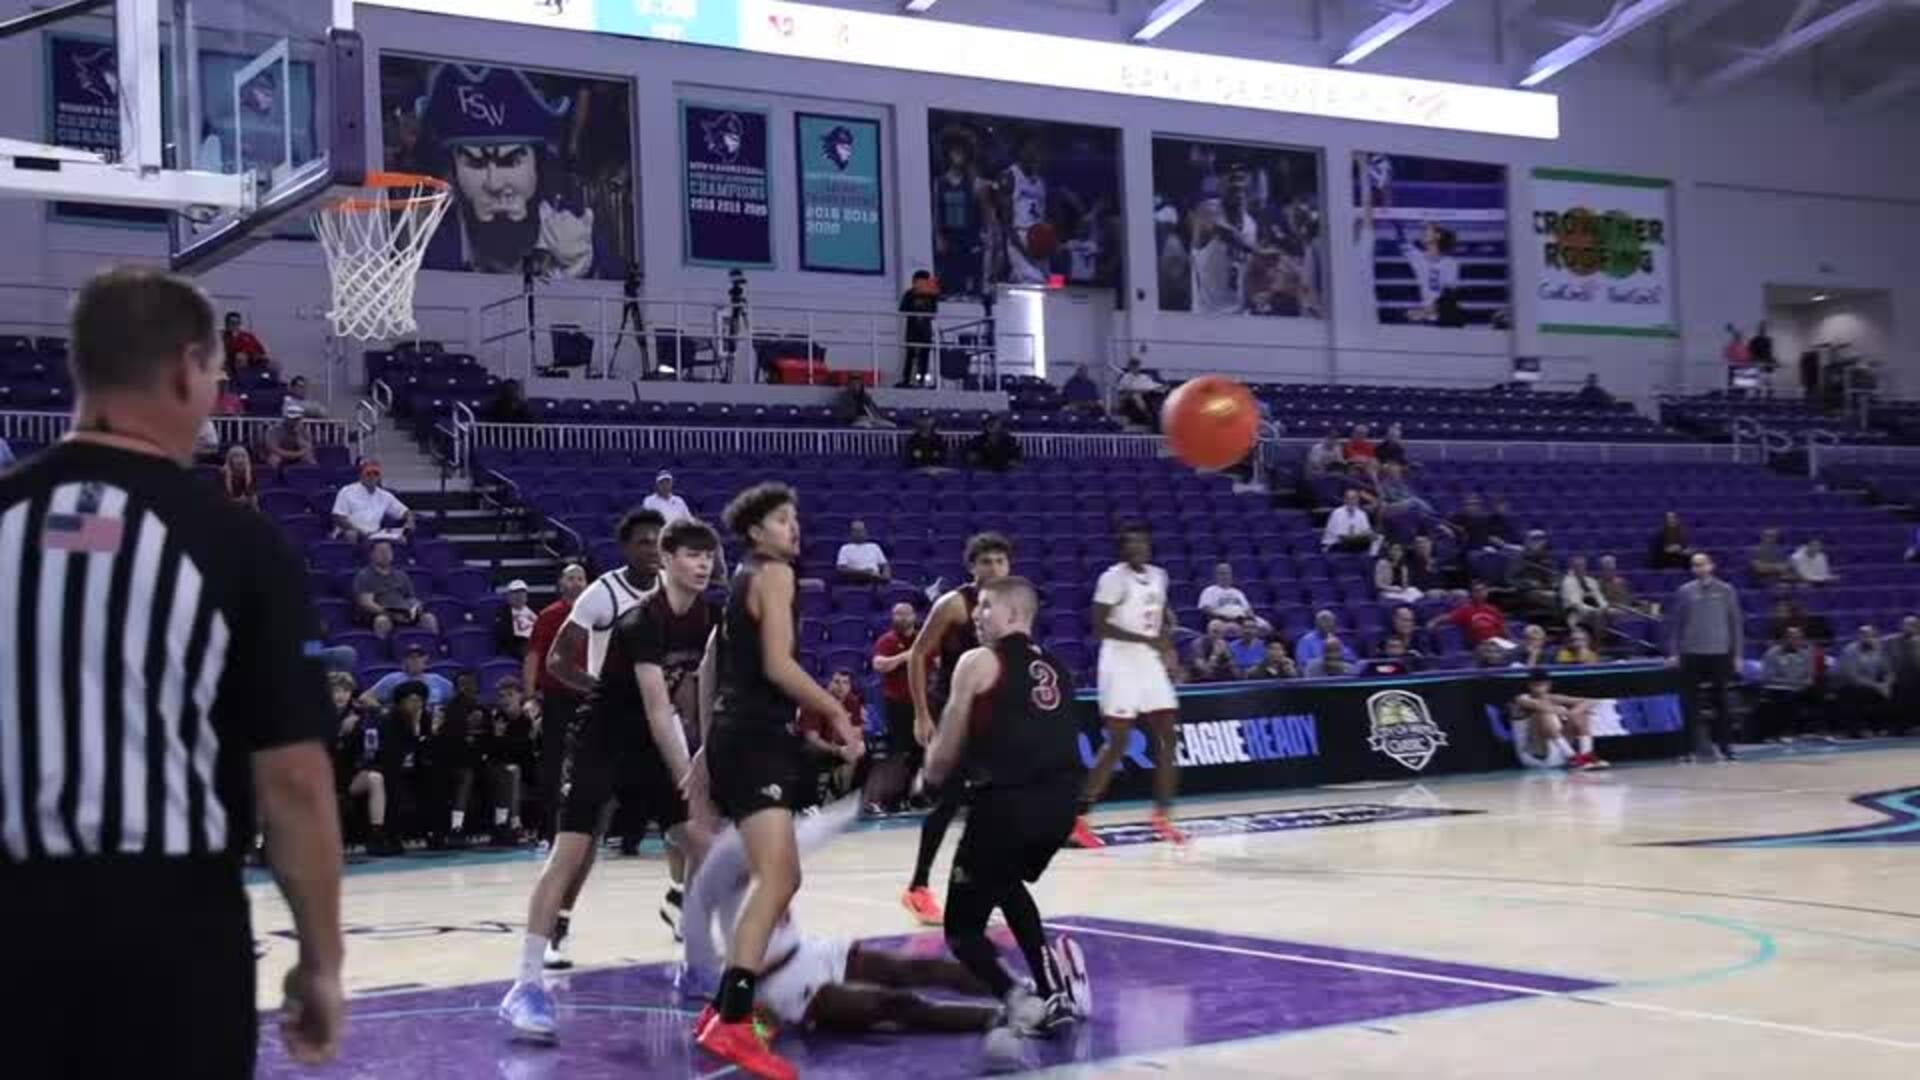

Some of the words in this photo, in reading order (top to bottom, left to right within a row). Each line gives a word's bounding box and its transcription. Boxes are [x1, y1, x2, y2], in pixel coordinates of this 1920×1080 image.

[457, 86, 505, 126] FSW
[1028, 660, 1061, 711] 3
[1172, 715, 1319, 767] EAGUEREADY
